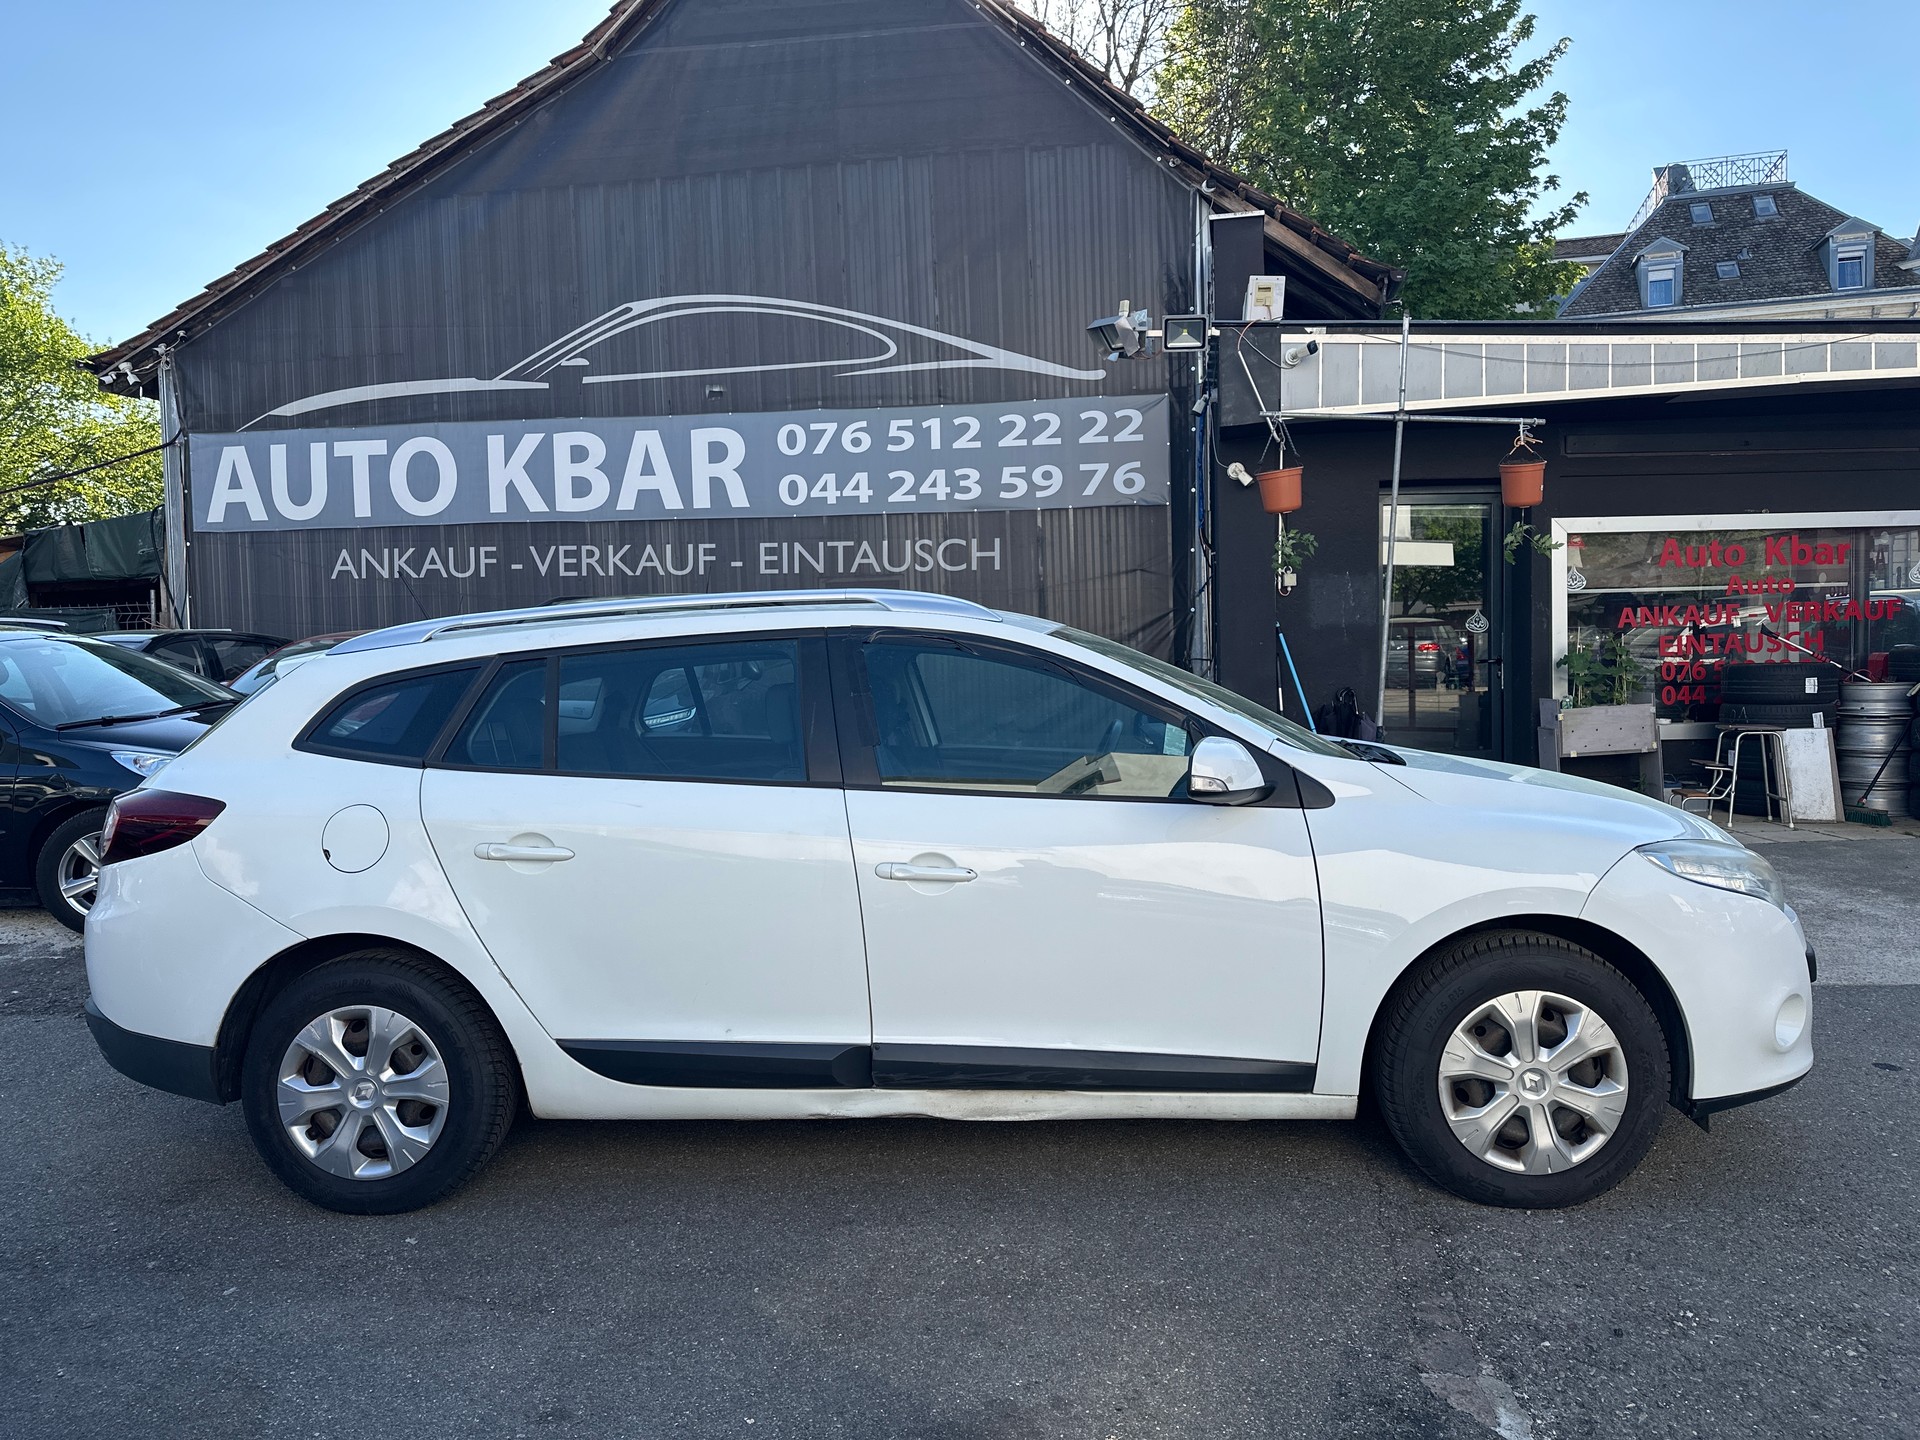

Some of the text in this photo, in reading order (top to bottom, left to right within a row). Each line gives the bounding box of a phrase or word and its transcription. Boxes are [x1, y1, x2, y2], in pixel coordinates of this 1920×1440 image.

[776, 408, 1144, 456] 076 512 22 22
[206, 427, 751, 523] AUTO KBAR
[778, 460, 1146, 506] 044 243 59 76
[330, 546, 497, 580] ANKAUF
[528, 542, 717, 577] VERKAUF
[759, 537, 1001, 575] EINTAUSCH
[1658, 535, 1851, 568] Auto Kbar
[1725, 574, 1796, 596] Auto
[1617, 604, 1740, 629] ANKAUF
[1765, 599, 1902, 624] VERKAUF
[1658, 630, 1825, 657] EINTAUSCH
[1661, 661, 1707, 682] 076
[1661, 685, 1707, 705] 044
